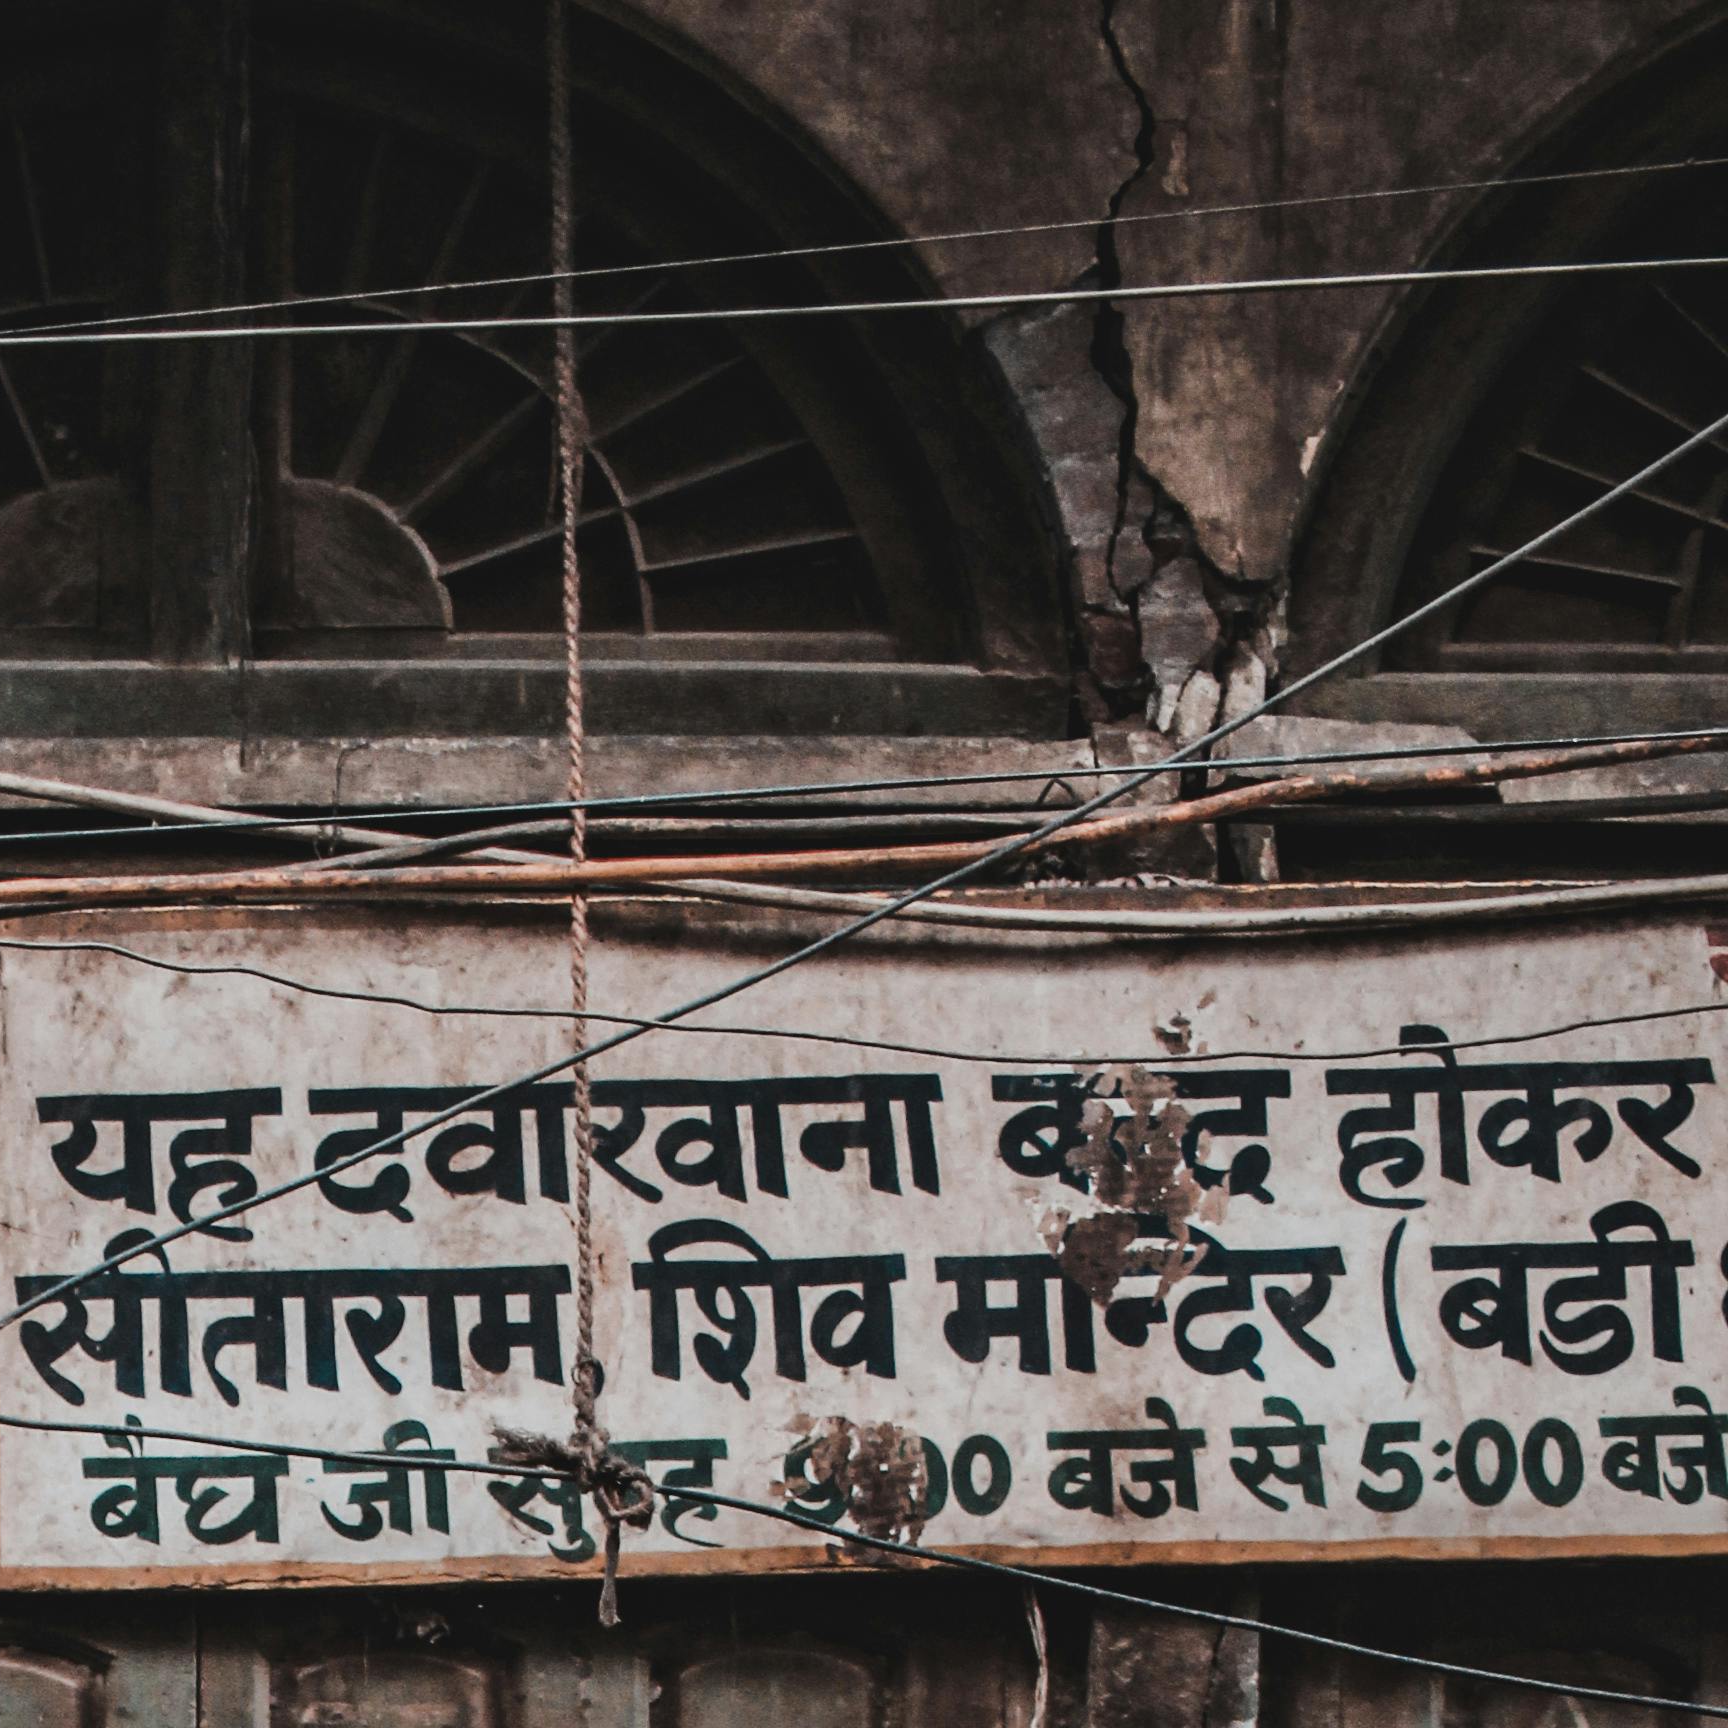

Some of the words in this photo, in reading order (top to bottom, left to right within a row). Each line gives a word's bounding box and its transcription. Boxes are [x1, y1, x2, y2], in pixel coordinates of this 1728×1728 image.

[36, 1086, 283, 1242] यह
[1324, 1023, 1715, 1209] होकर
[14, 1227, 573, 1408] सीताराम
[631, 1218, 907, 1402] शिव
[320, 1418, 456, 1542] जी
[1047, 1395, 1206, 1519] बजे
[1229, 1395, 1328, 1513] से
[1356, 1416, 1584, 1515] 5:00
